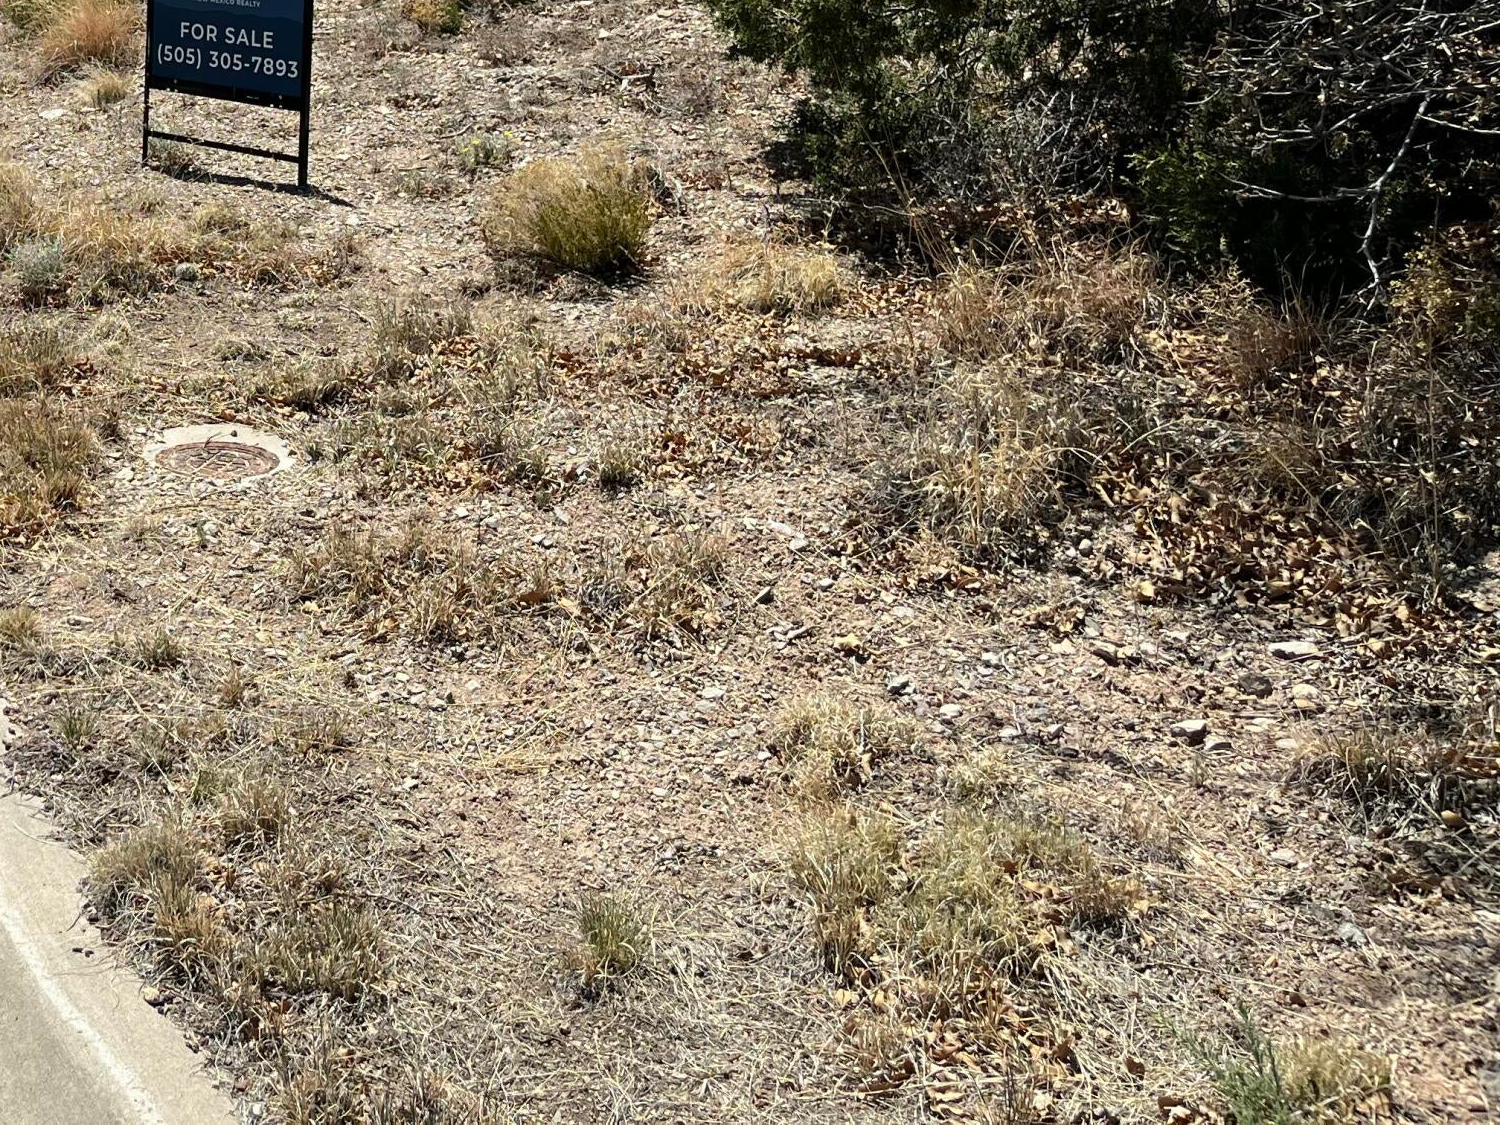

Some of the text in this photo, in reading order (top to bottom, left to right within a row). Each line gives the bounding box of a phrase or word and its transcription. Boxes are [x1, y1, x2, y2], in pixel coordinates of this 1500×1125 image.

[236, 0, 261, 8] REALTY
[180, 22, 274, 49] FOR SALE
[157, 43, 298, 78] (505) 305-7893
